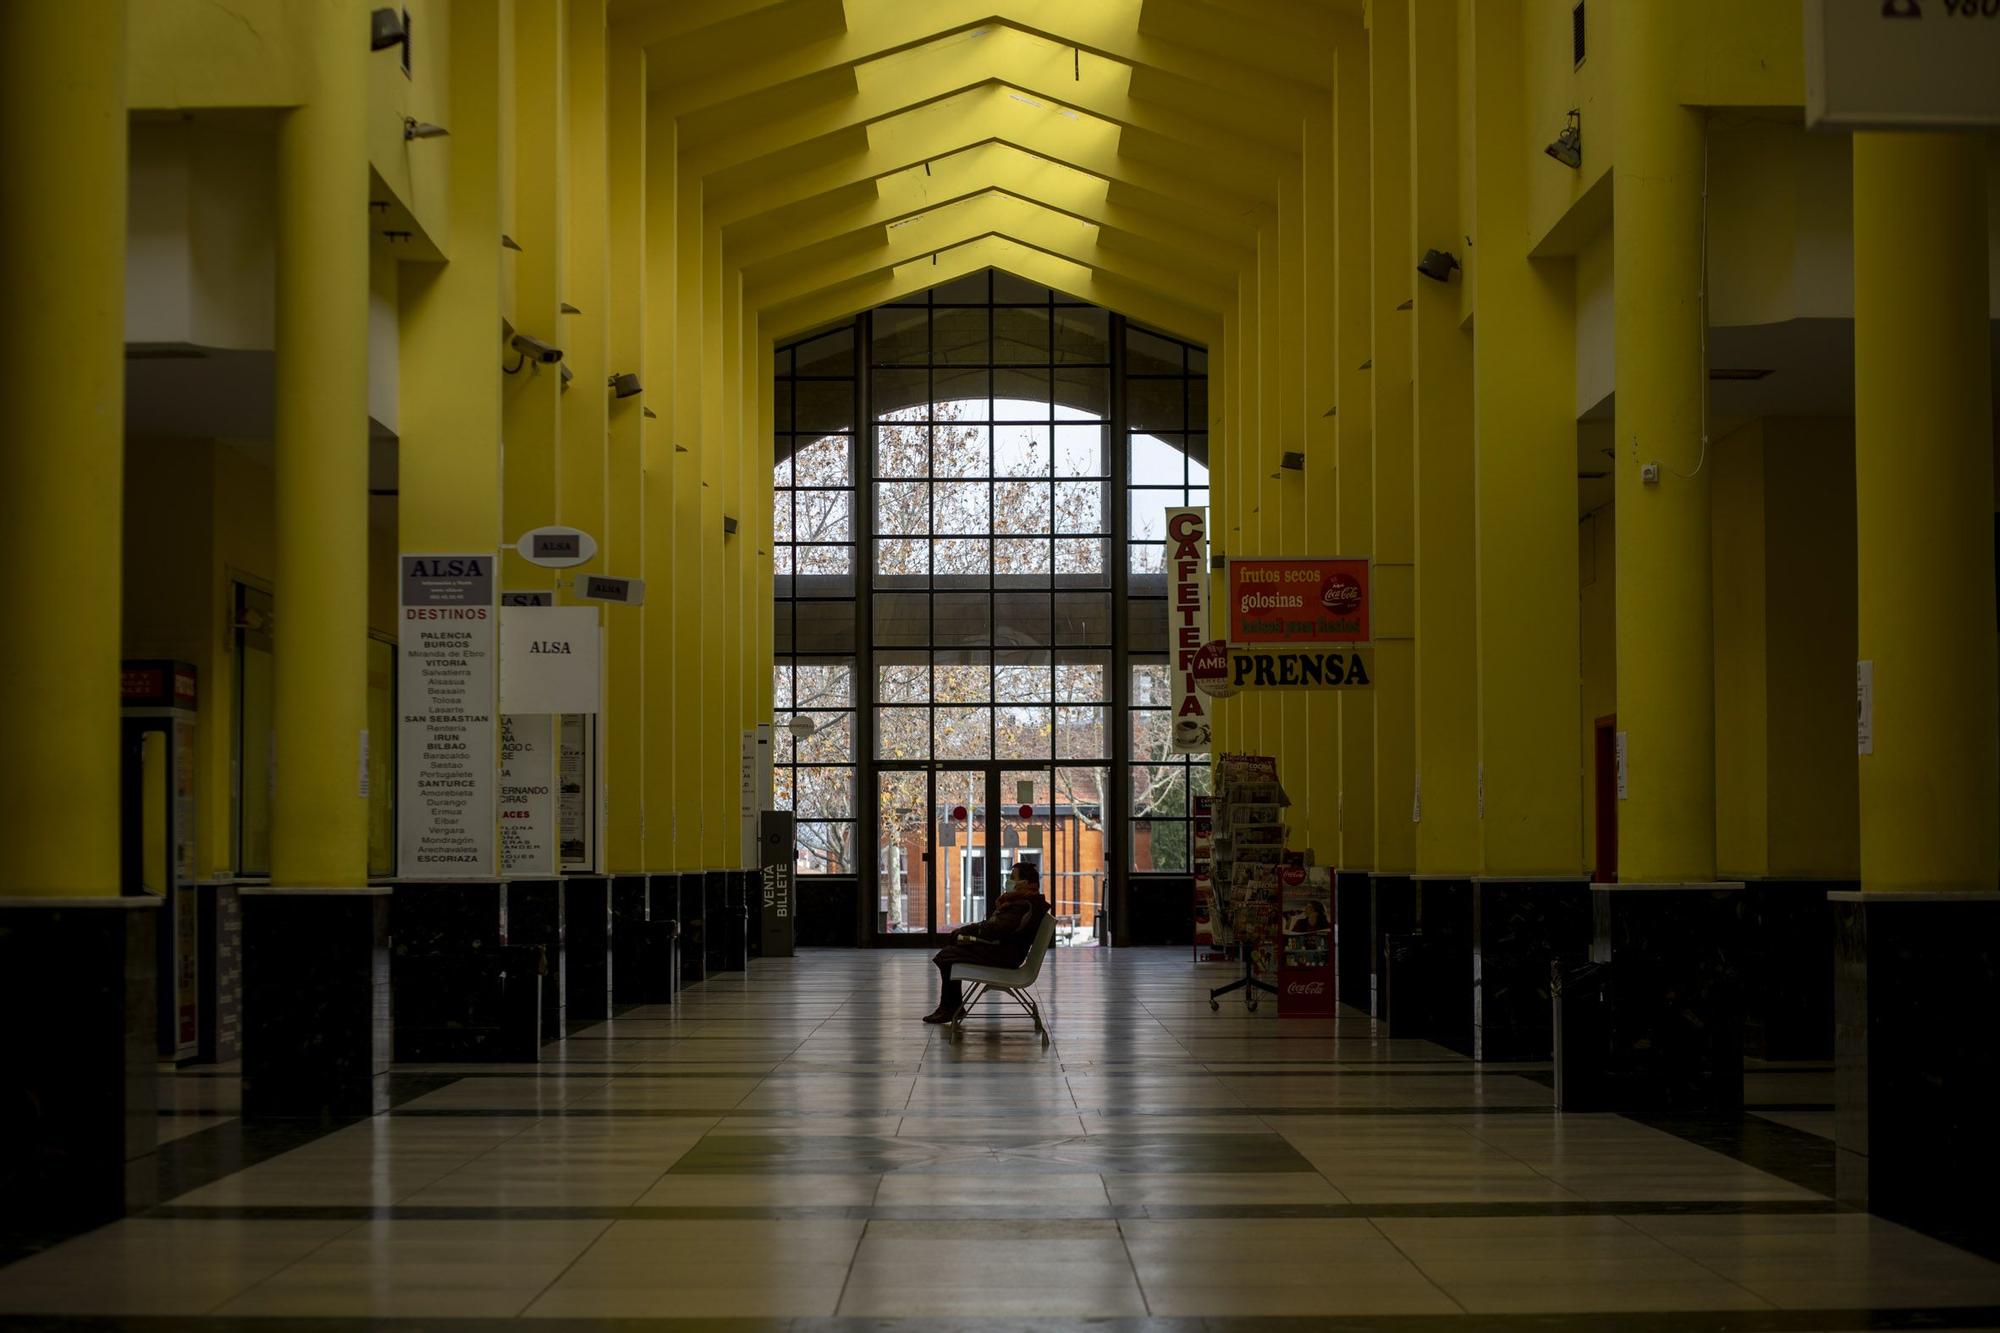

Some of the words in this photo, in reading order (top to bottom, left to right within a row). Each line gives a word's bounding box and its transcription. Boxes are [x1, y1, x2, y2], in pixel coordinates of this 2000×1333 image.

[541, 543, 572, 551] ALSA
[410, 559, 483, 577] ALSA
[1239, 566, 1281, 583] frutos
[1284, 568, 1321, 583] secos
[1241, 592, 1304, 614] golosinas
[406, 608, 487, 620] DESTINOS
[529, 641, 572, 654] ALSA
[408, 650, 446, 658] Miranda
[448, 650, 460, 658] de
[426, 659, 468, 667] VITORIA
[1233, 653, 1370, 686] PRENSA
[427, 678, 465, 686] Alsasua
[427, 687, 466, 695] Beasain
[431, 696, 462, 704] Tolosa
[428, 706, 464, 714] Lasarte
[405, 715, 426, 723] SAN
[429, 715, 489, 723] SEBASTIAN
[434, 733, 459, 741] IRUN
[427, 742, 466, 750] BILBAO
[423, 752, 470, 760] Baracaldo
[430, 761, 464, 769] Sestao
[419, 770, 473, 779] Portugalete
[420, 789, 473, 797] Amorebieta
[426, 799, 467, 808] Durango
[431, 808, 462, 816] Ermua
[434, 817, 459, 825] Eibar
[428, 826, 465, 835] Vergara
[418, 846, 478, 854] Arechavaleta
[417, 855, 478, 863] ESCORIAZA
[762, 864, 775, 908] VENTA
[776, 863, 788, 918] BILLETE
